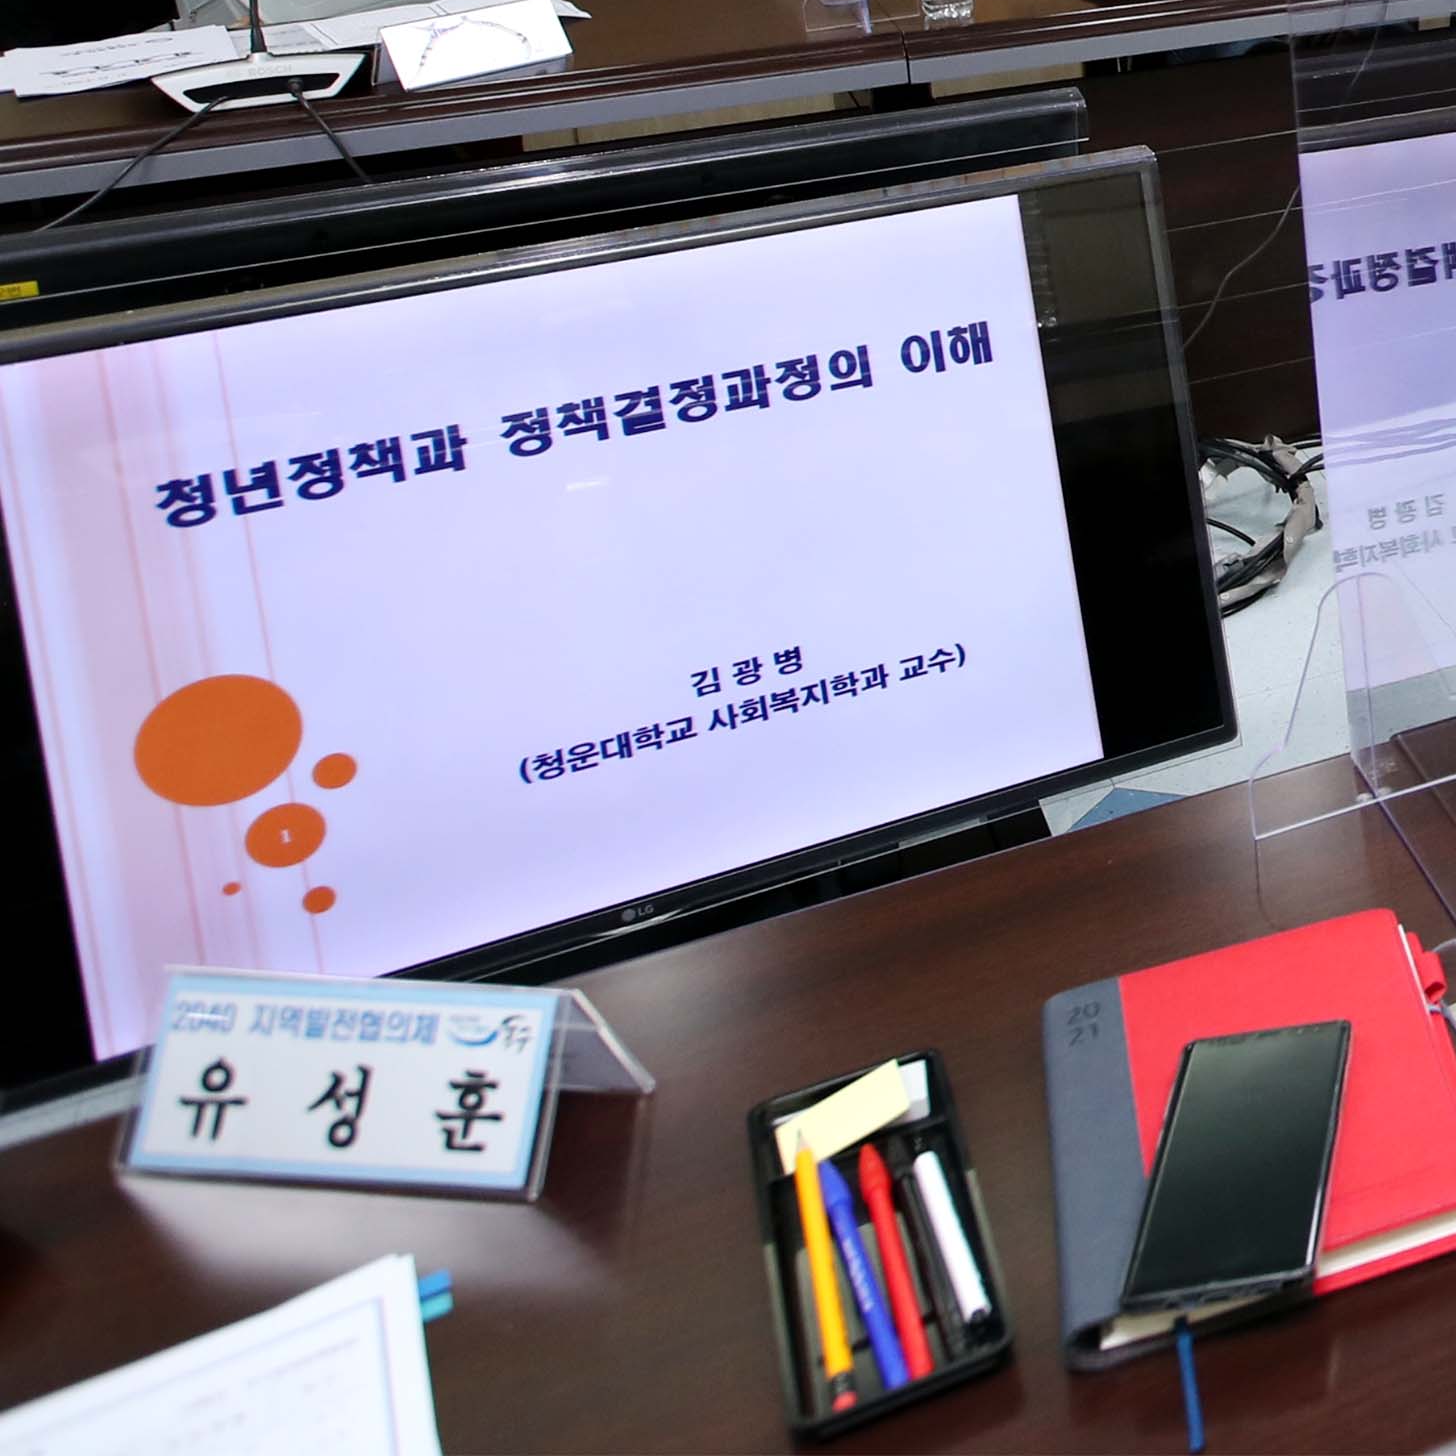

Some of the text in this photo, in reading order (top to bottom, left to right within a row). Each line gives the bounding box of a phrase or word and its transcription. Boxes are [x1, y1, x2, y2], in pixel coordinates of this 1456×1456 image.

[156, 321, 994, 528] 청년정책과 정책결정과정의 이해
[519, 642, 967, 785] (청운대학교 사회복지학과 교수)
[638, 904, 654, 916] LG
